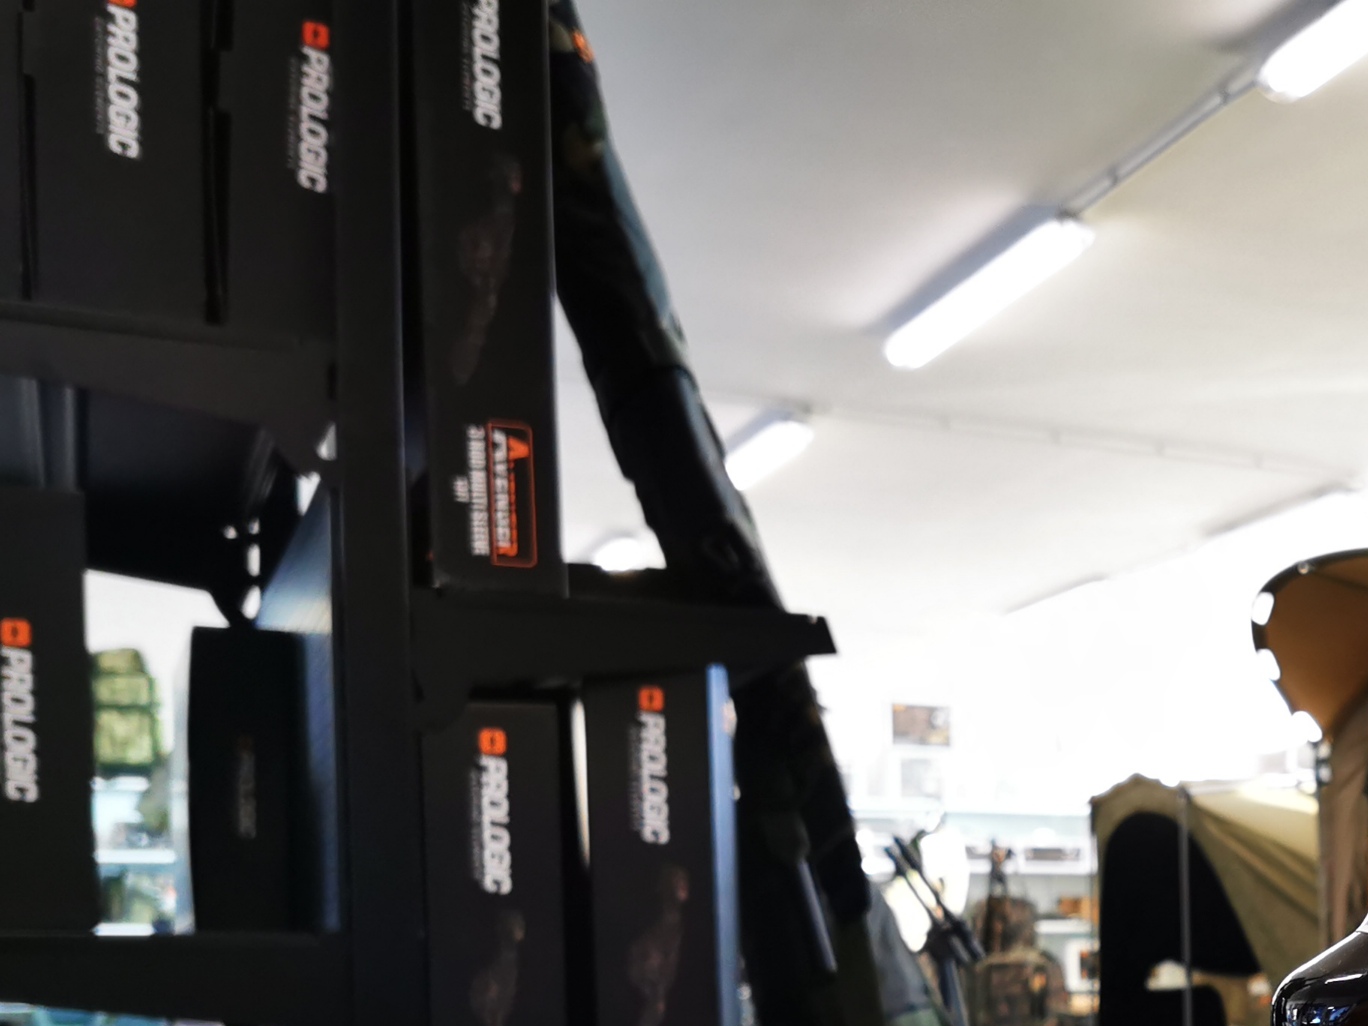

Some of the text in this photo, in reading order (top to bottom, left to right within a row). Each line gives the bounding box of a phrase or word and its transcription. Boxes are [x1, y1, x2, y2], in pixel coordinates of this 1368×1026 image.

[107, 3, 140, 159] PROLOGIC
[297, 45, 330, 194] PROLOGIC
[1, 647, 38, 803] PROLOGIC
[639, 711, 671, 845] PROLOGIC
[480, 755, 512, 895] PROLOGIC
